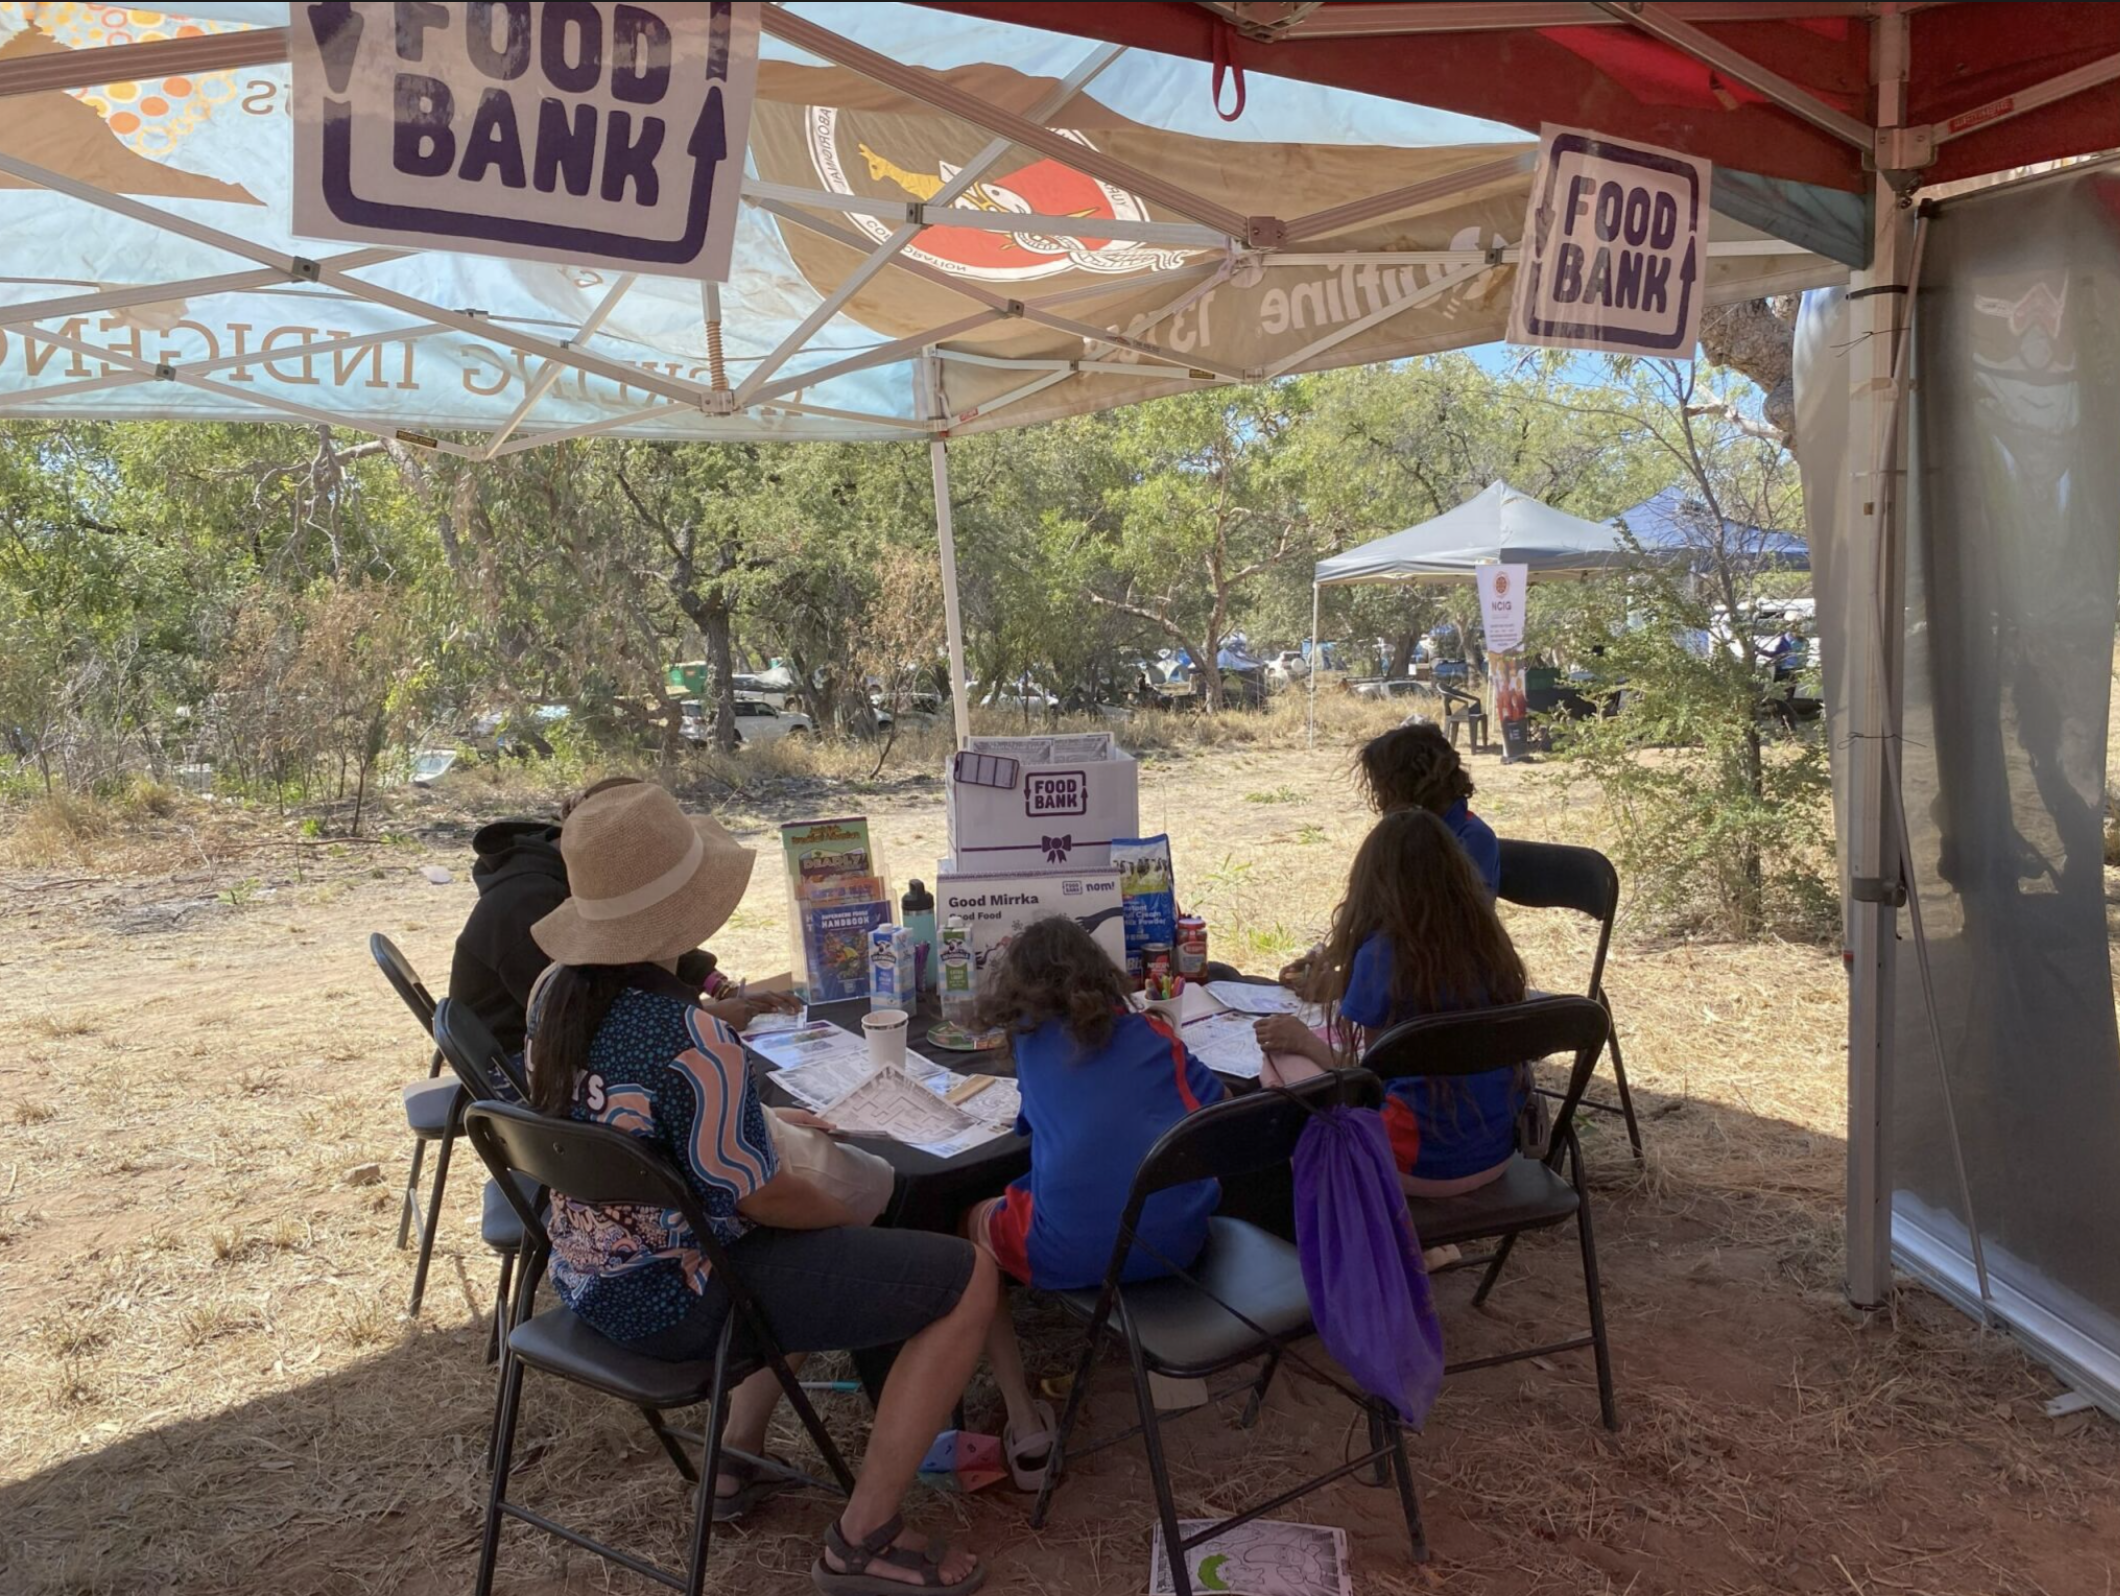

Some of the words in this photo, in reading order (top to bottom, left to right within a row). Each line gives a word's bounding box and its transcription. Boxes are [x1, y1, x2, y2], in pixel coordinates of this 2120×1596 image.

[394, 2, 672, 104] FOOD
[393, 73, 665, 206] BANK
[1564, 175, 1677, 250] FOOD
[1553, 243, 1672, 313] BANK
[1034, 779, 1077, 794] FOOD
[1034, 794, 1078, 809] BANK
[948, 895, 986, 908] Good
[990, 893, 1039, 906] Mirrka
[821, 916, 869, 929] HANDBOOK
[978, 911, 1002, 920] Food
